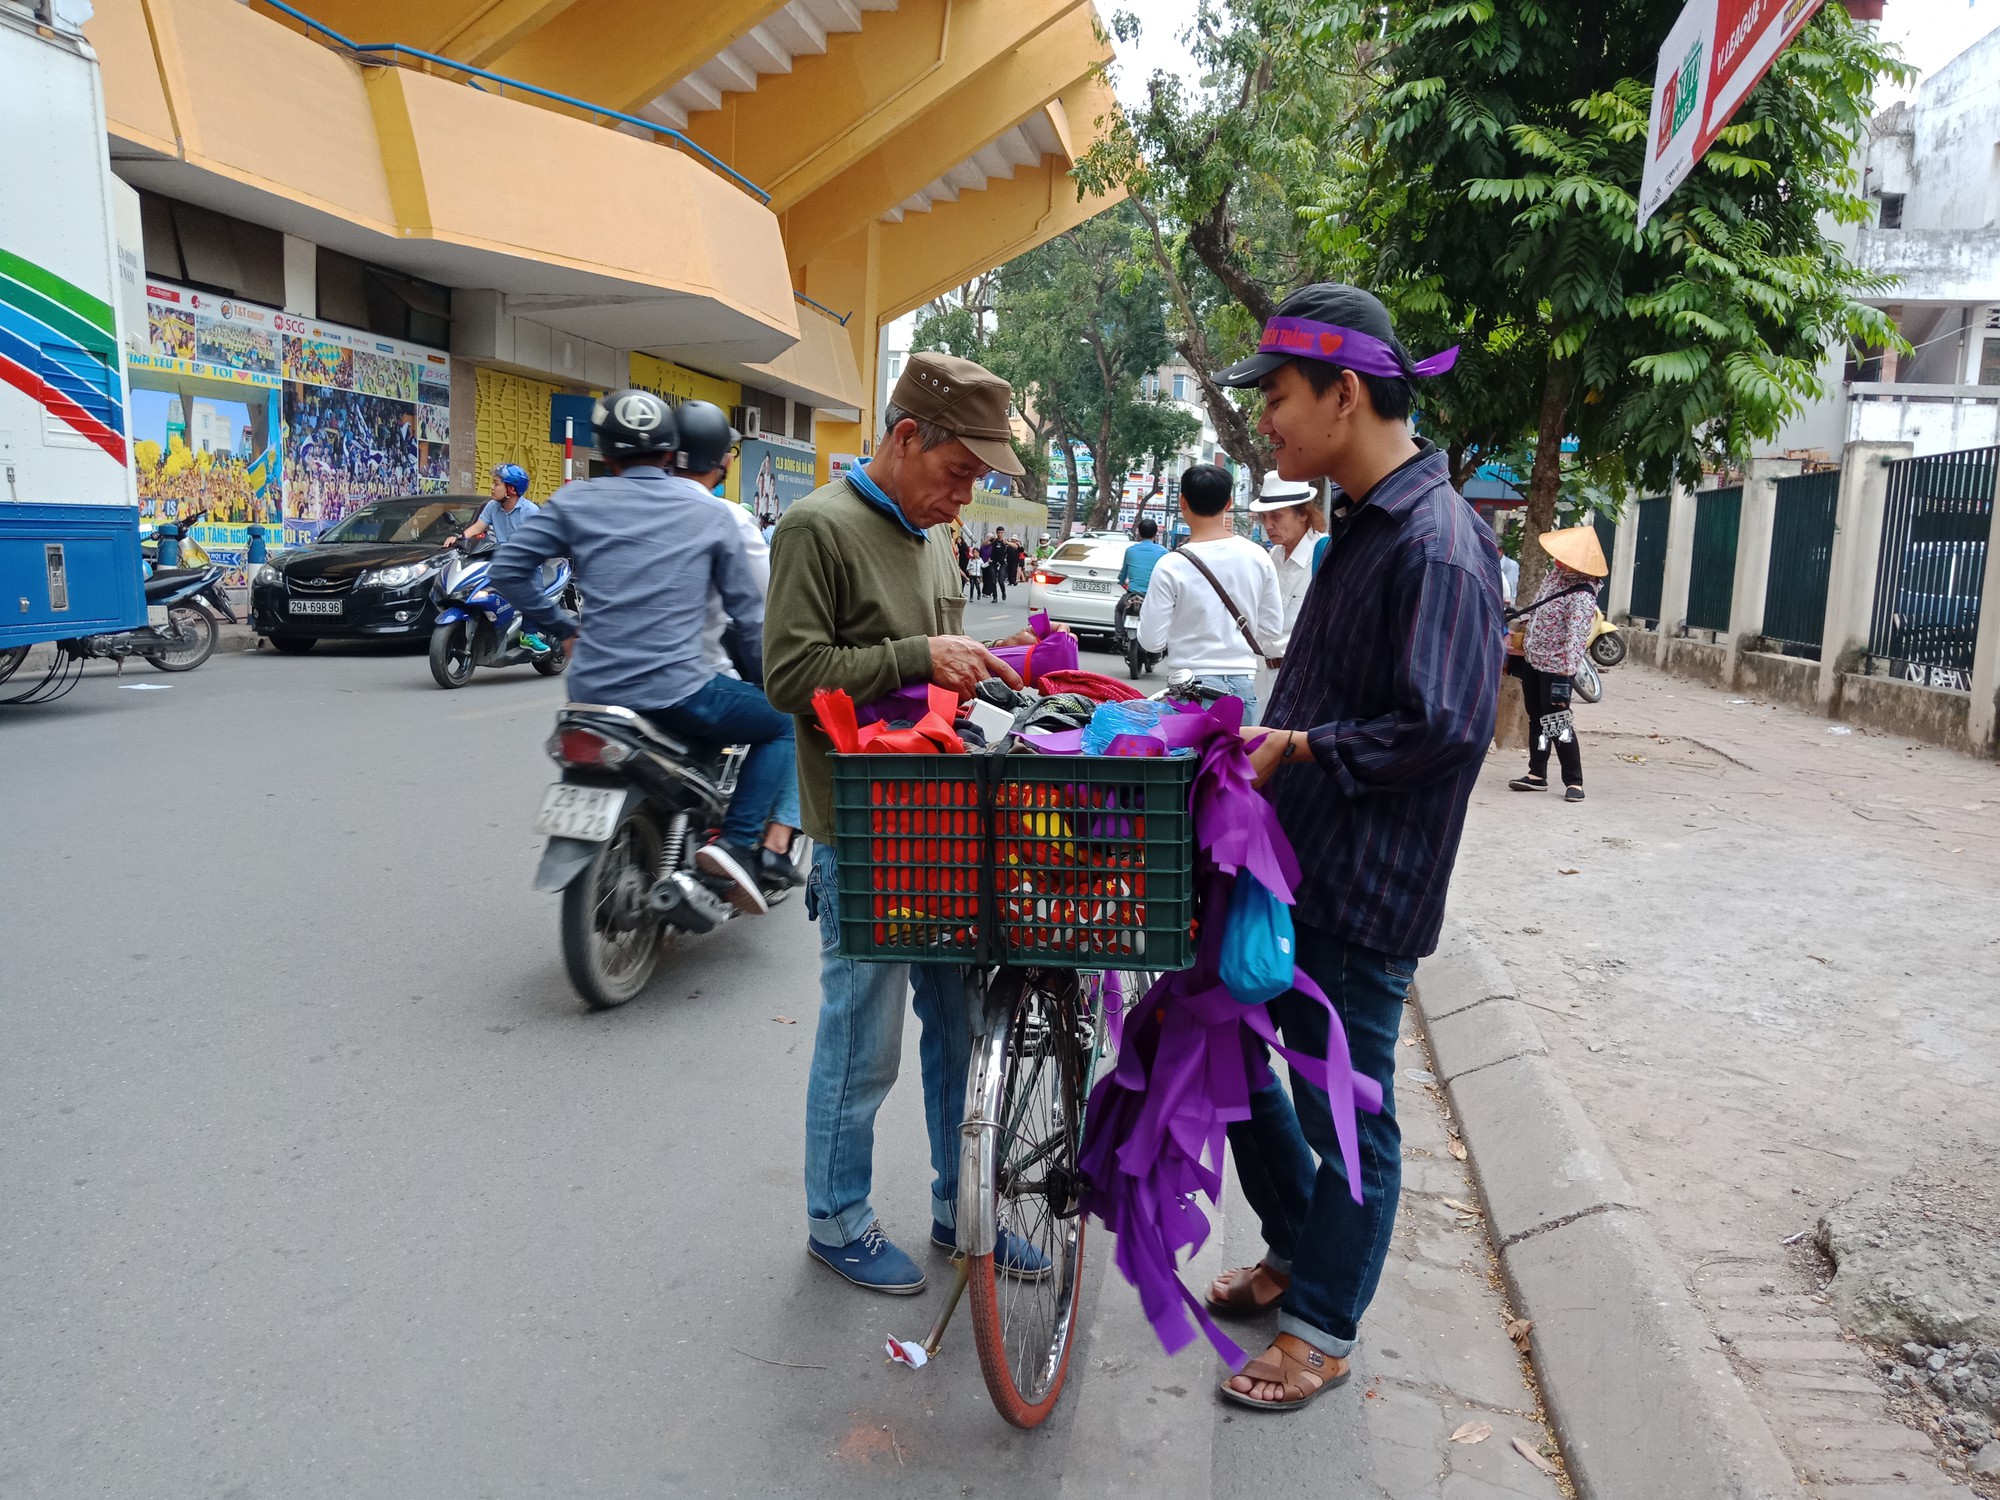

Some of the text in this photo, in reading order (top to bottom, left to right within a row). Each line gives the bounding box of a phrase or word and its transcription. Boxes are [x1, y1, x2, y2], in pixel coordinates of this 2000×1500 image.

[1717, 0, 1760, 76] V.LEAGUE
[234, 305, 265, 321] T&T GROUP
[285, 318, 305, 334] SCG
[298, 530, 312, 544] FC
[291, 601, 339, 613] 29A-698.96
